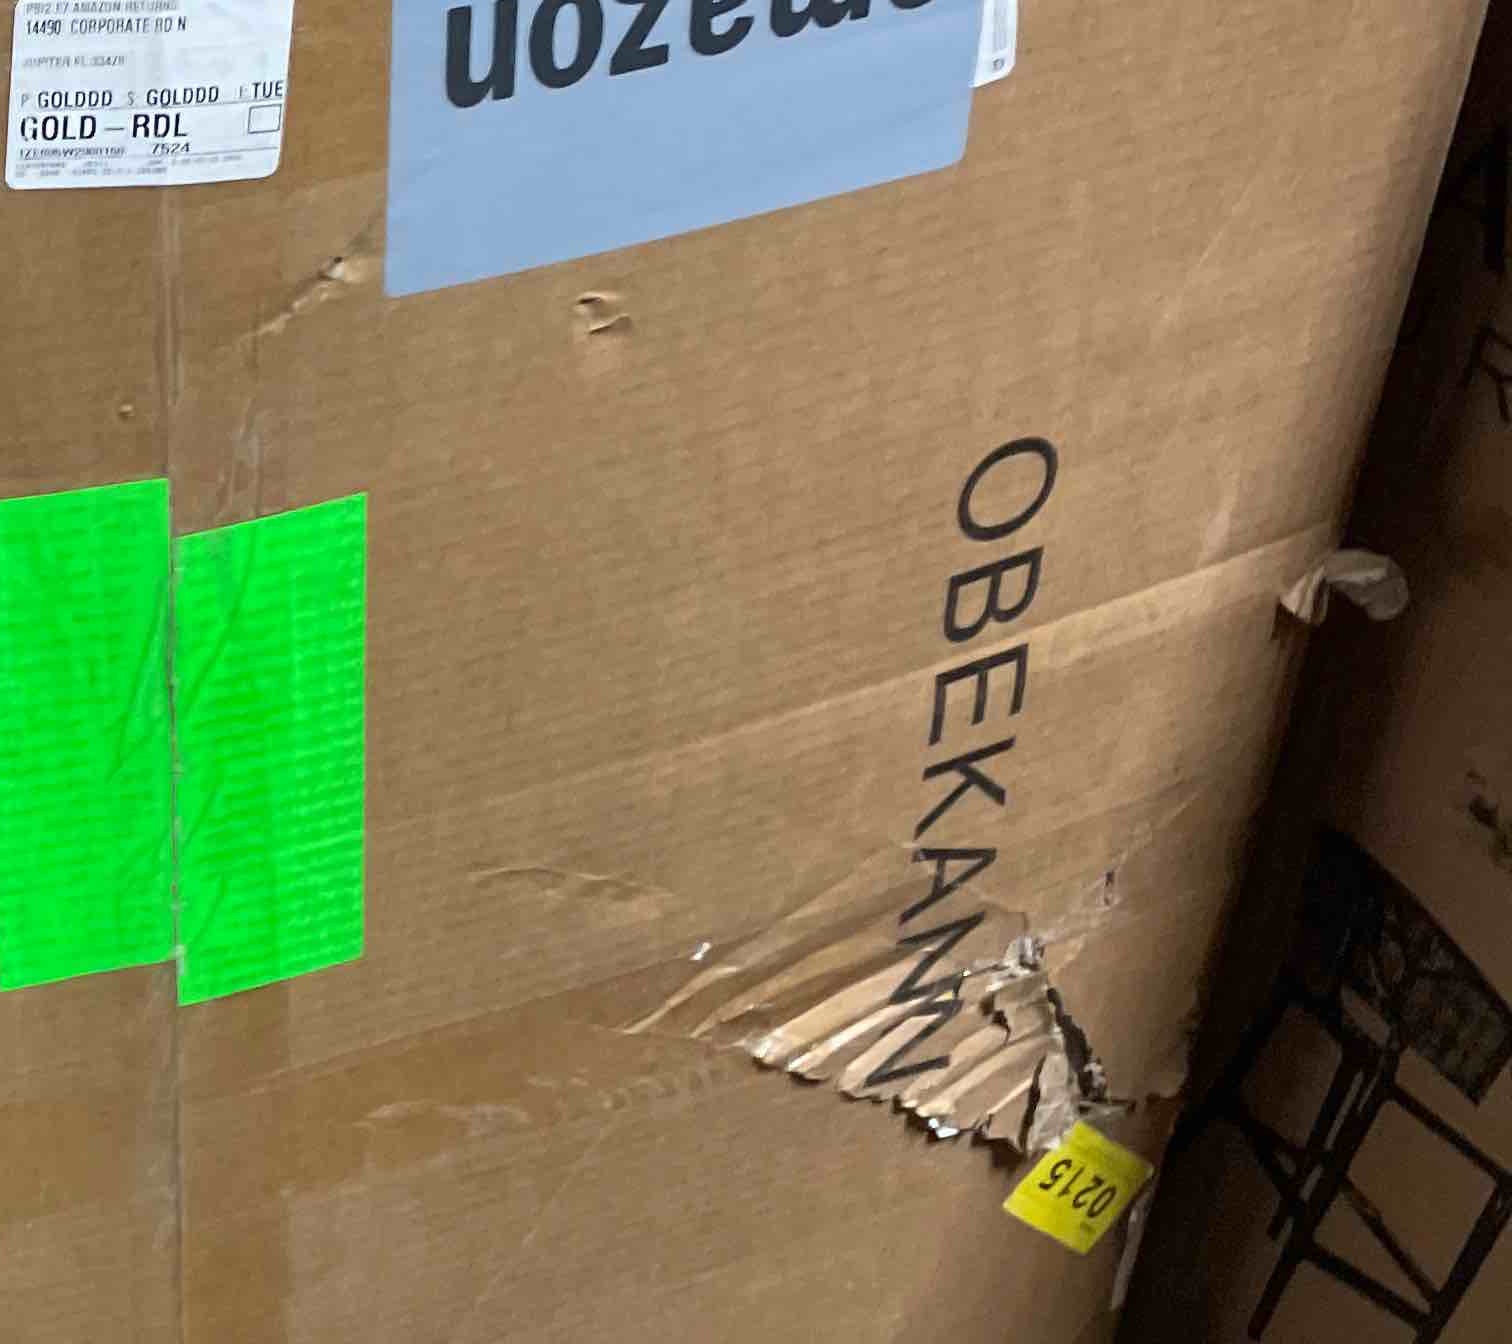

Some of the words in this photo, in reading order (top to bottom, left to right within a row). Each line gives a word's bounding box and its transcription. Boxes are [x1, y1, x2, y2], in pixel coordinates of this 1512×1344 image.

[25, 19, 62, 36] 14490
[70, 17, 151, 35] CORPORATE
[153, 17, 173, 33] RD
[177, 16, 187, 32] N
[37, 90, 113, 109] GOLDDD
[146, 86, 220, 106] GOLDDD
[252, 80, 284, 99] TUE
[151, 142, 191, 155] 7524
[1038, 1158, 1117, 1219] 0215
